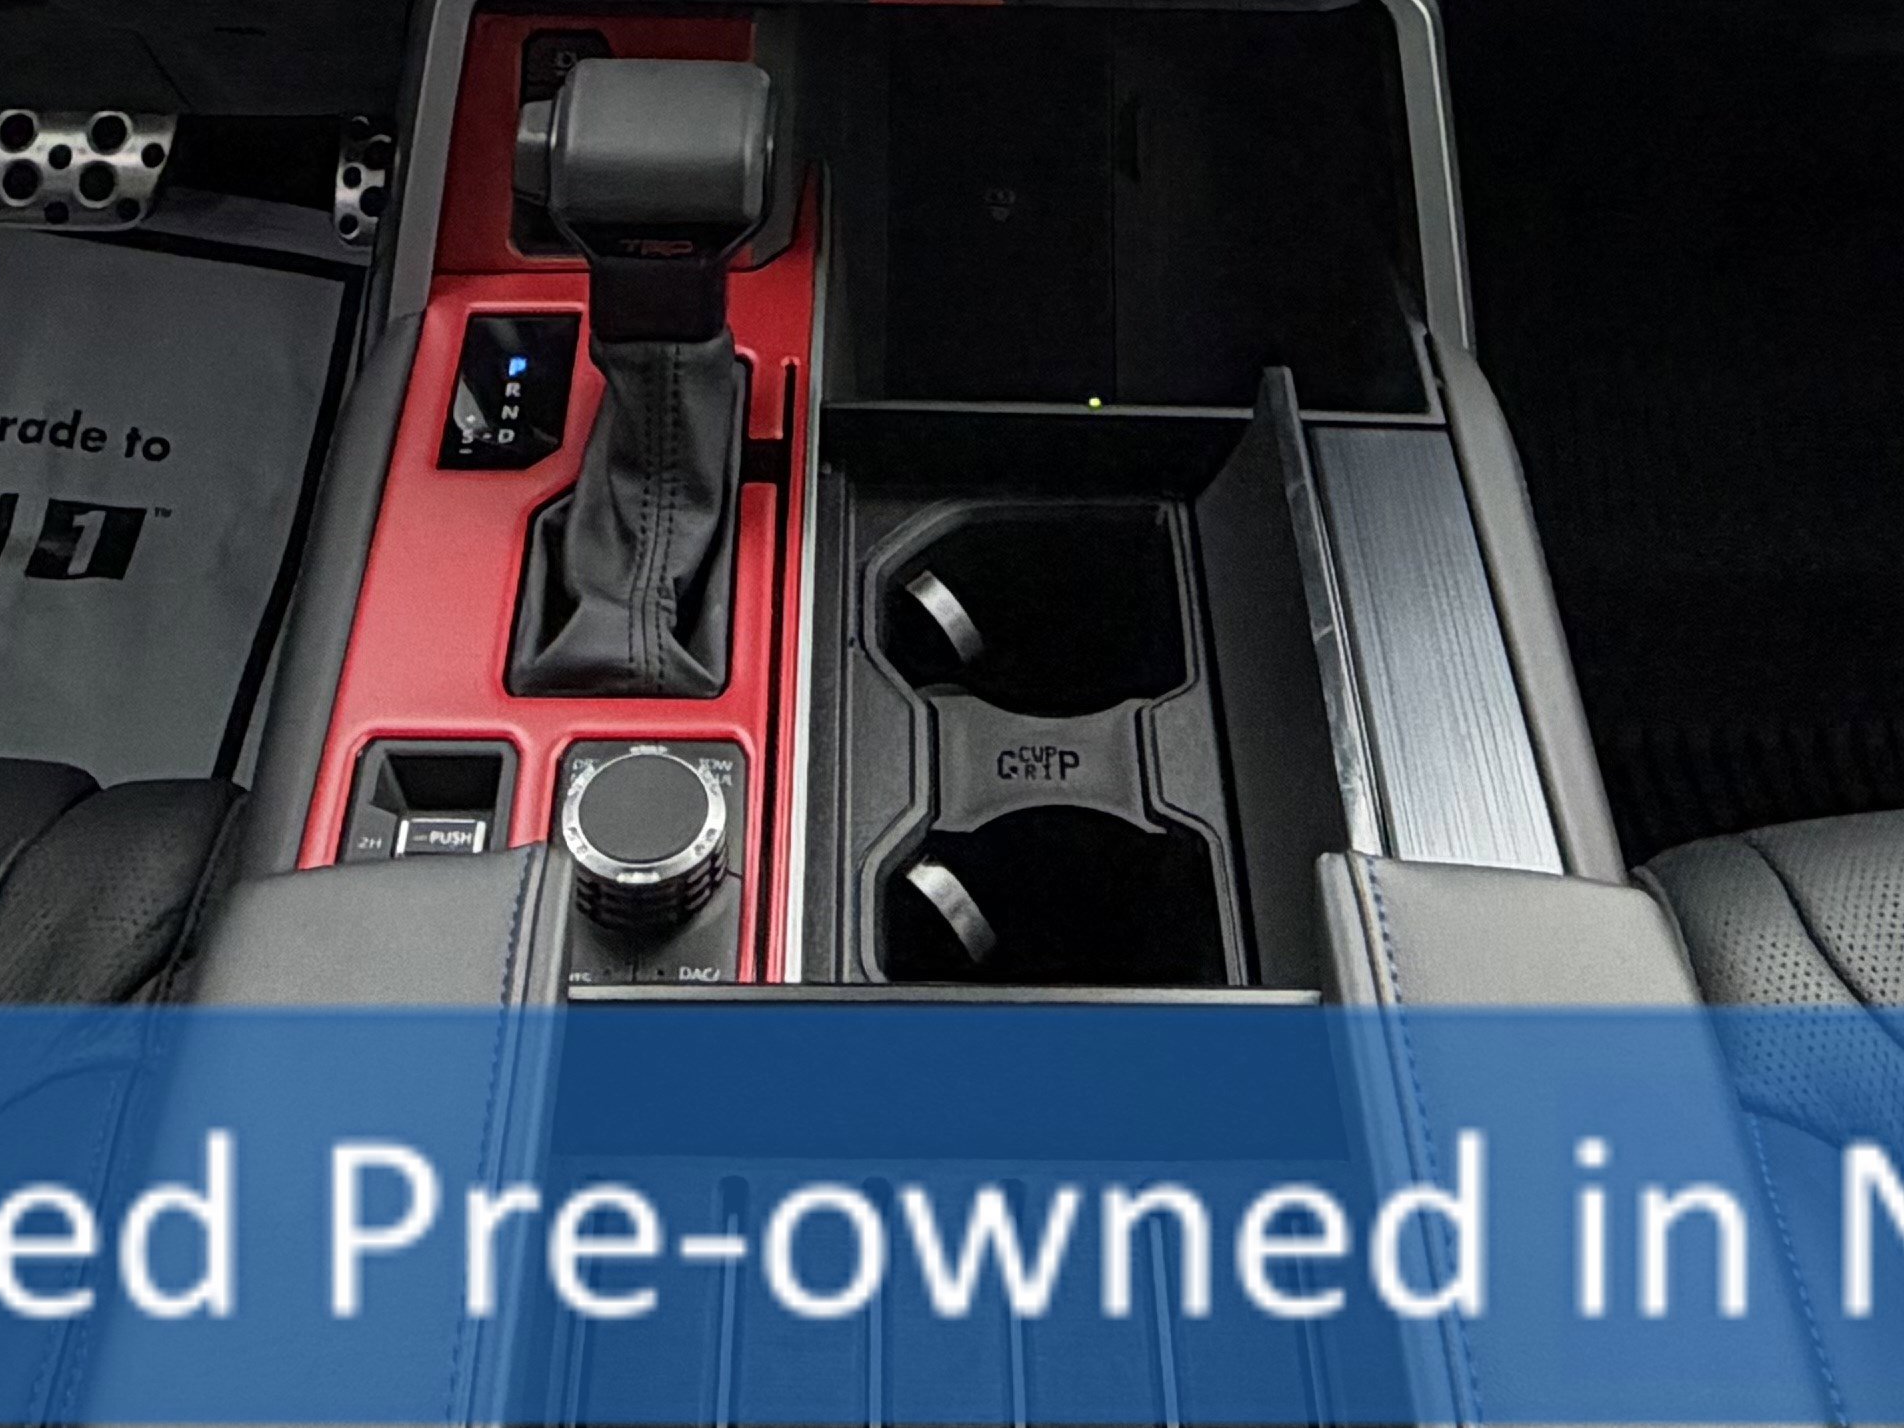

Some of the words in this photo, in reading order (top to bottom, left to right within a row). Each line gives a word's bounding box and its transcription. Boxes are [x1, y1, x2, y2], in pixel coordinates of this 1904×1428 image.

[507, 355, 530, 378] P
[504, 381, 521, 398] R
[500, 404, 520, 421] N
[123, 423, 172, 464] to
[460, 427, 475, 445] S
[497, 428, 516, 445] D
[1018, 745, 1057, 764] CUP
[357, 835, 383, 850] 2H
[429, 830, 473, 846] PUSH
